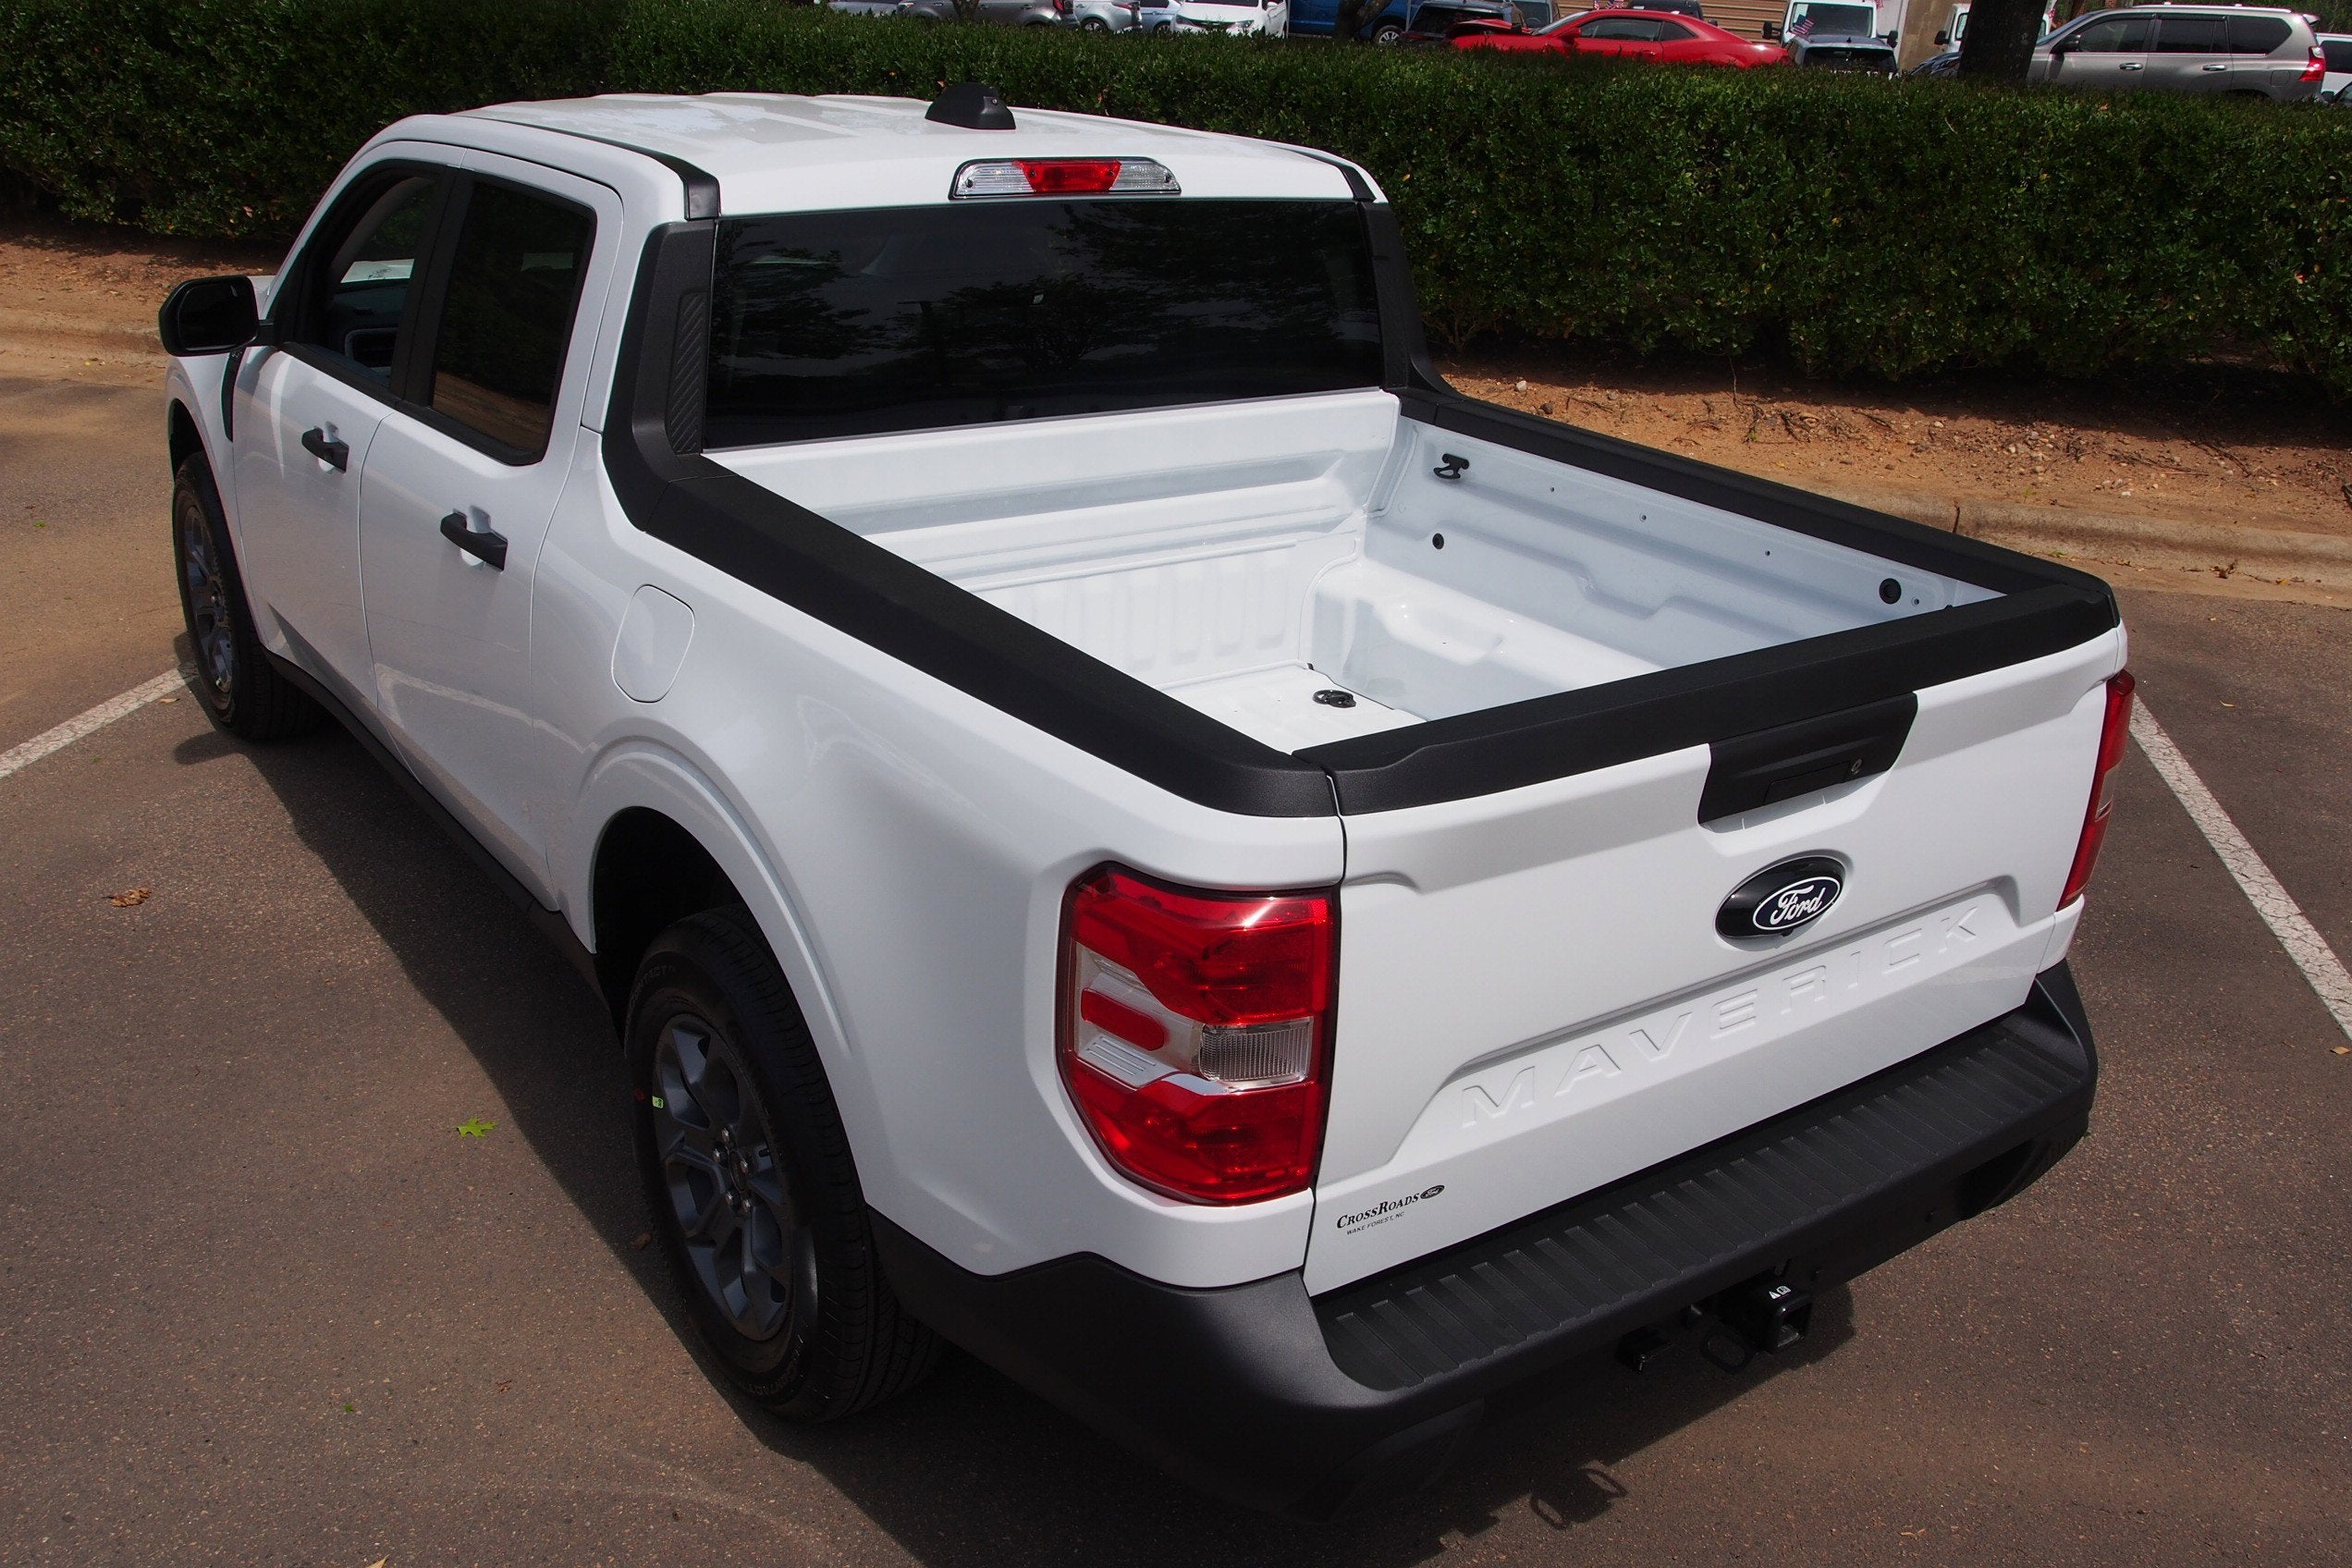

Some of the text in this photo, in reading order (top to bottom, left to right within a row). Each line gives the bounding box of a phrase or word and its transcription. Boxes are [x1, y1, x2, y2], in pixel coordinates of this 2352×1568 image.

[1770, 885, 1826, 925] Ford
[1461, 905, 1980, 1130] MAVERICK
[1346, 1224, 1366, 1236] WAKE
